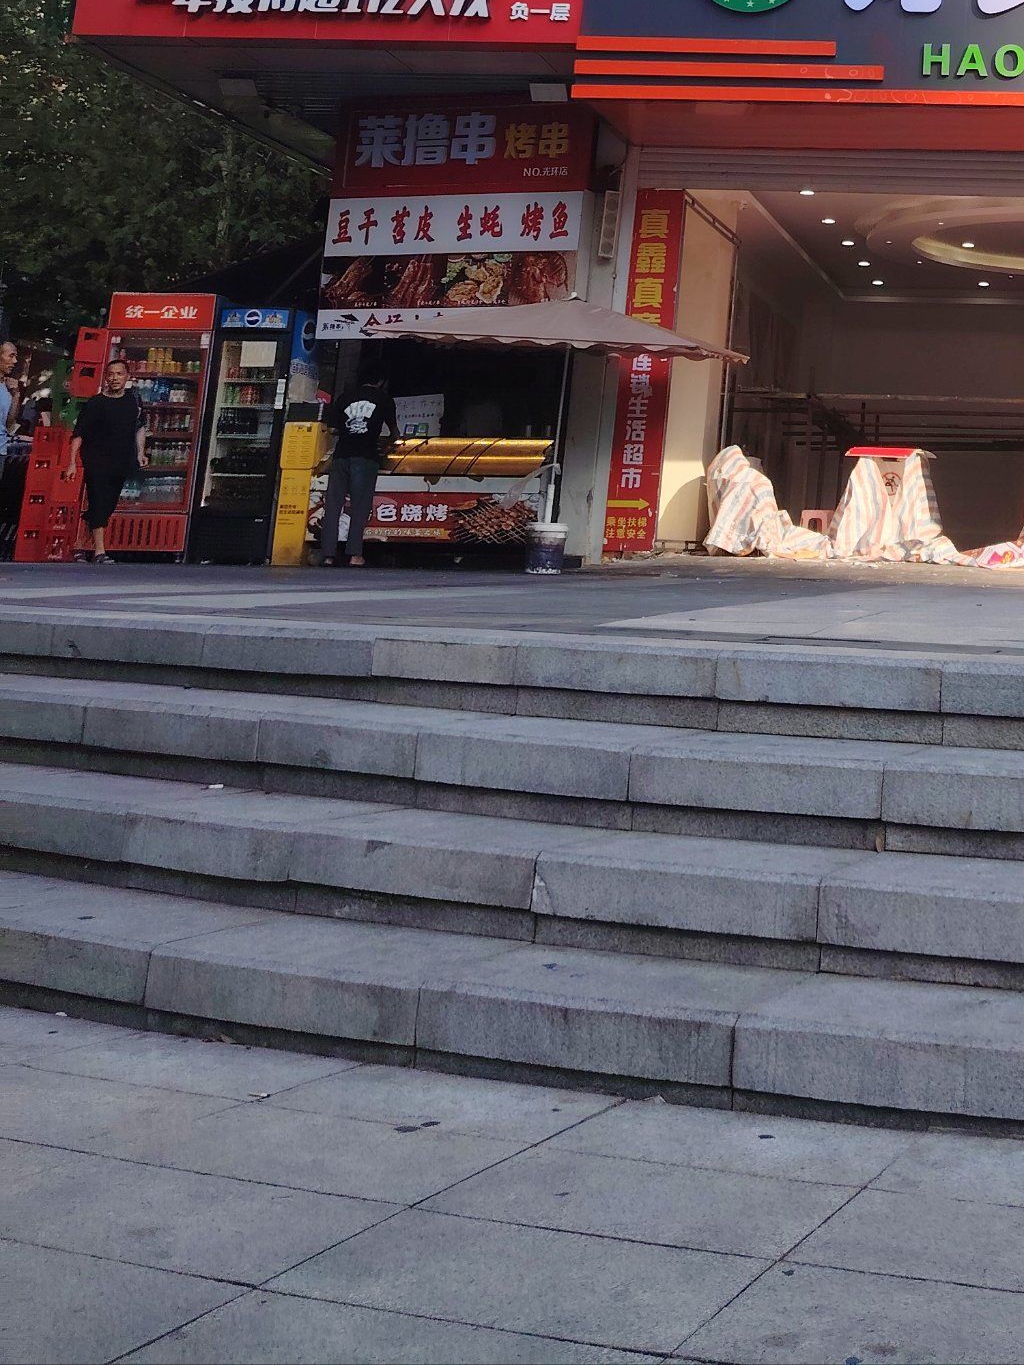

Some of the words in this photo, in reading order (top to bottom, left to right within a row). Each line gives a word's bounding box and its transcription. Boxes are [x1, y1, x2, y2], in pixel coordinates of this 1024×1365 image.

[509, 1, 571, 22] 负一层
[355, 112, 497, 168] 莱撸串
[503, 122, 569, 160] 烤串
[332, 207, 378, 245] 豆干
[391, 205, 435, 245] 苕皮
[456, 204, 503, 242] 生蚝
[519, 200, 569, 242] 烤鱼
[632, 208, 670, 326] 真鑫真
[125, 305, 198, 320] 统一企业
[368, 503, 449, 522] 色烧烤
[606, 516, 648, 527] 乘坐扶梯
[606, 527, 647, 540] 注意安全
